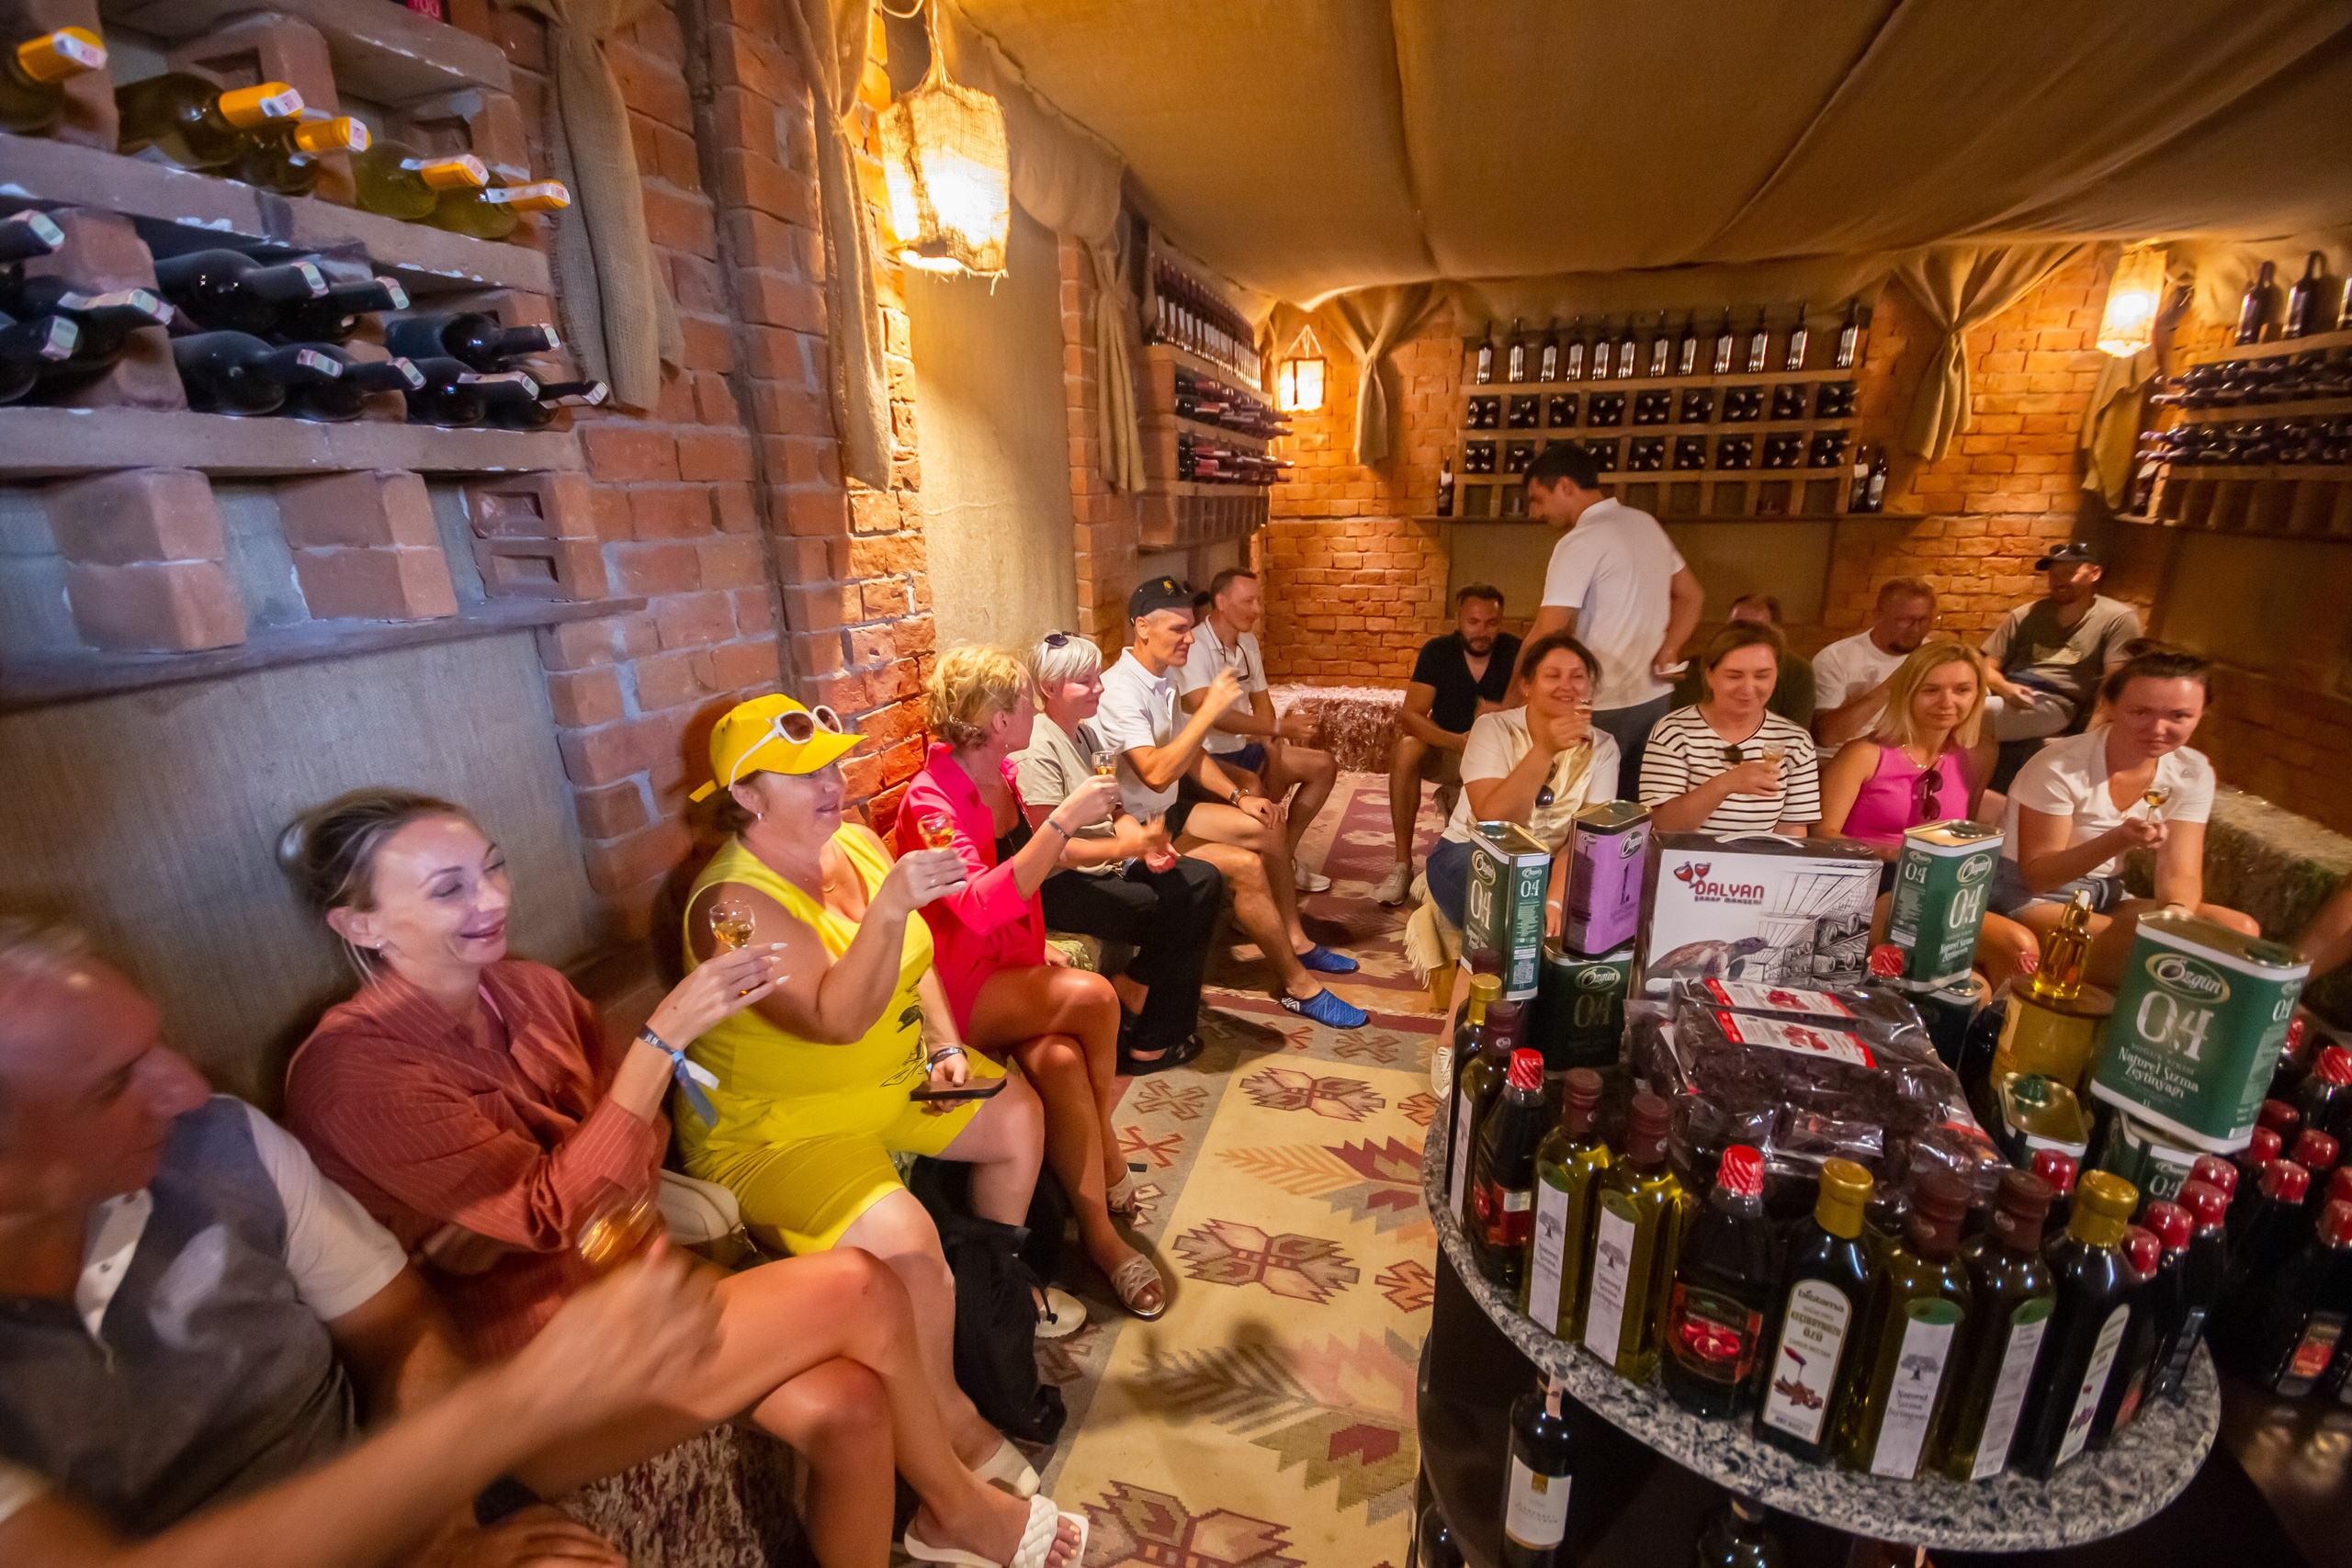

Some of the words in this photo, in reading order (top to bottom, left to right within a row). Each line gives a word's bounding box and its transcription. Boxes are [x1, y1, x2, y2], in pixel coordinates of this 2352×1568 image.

[1694, 880, 1765, 899] DALYAN
[1582, 968, 1615, 987] Özgün
[2157, 959, 2222, 995] Özgün
[2136, 990, 2214, 1062] 0.4
[2119, 1046, 2161, 1075] Naturel
[2165, 1066, 2199, 1093] Sızma
